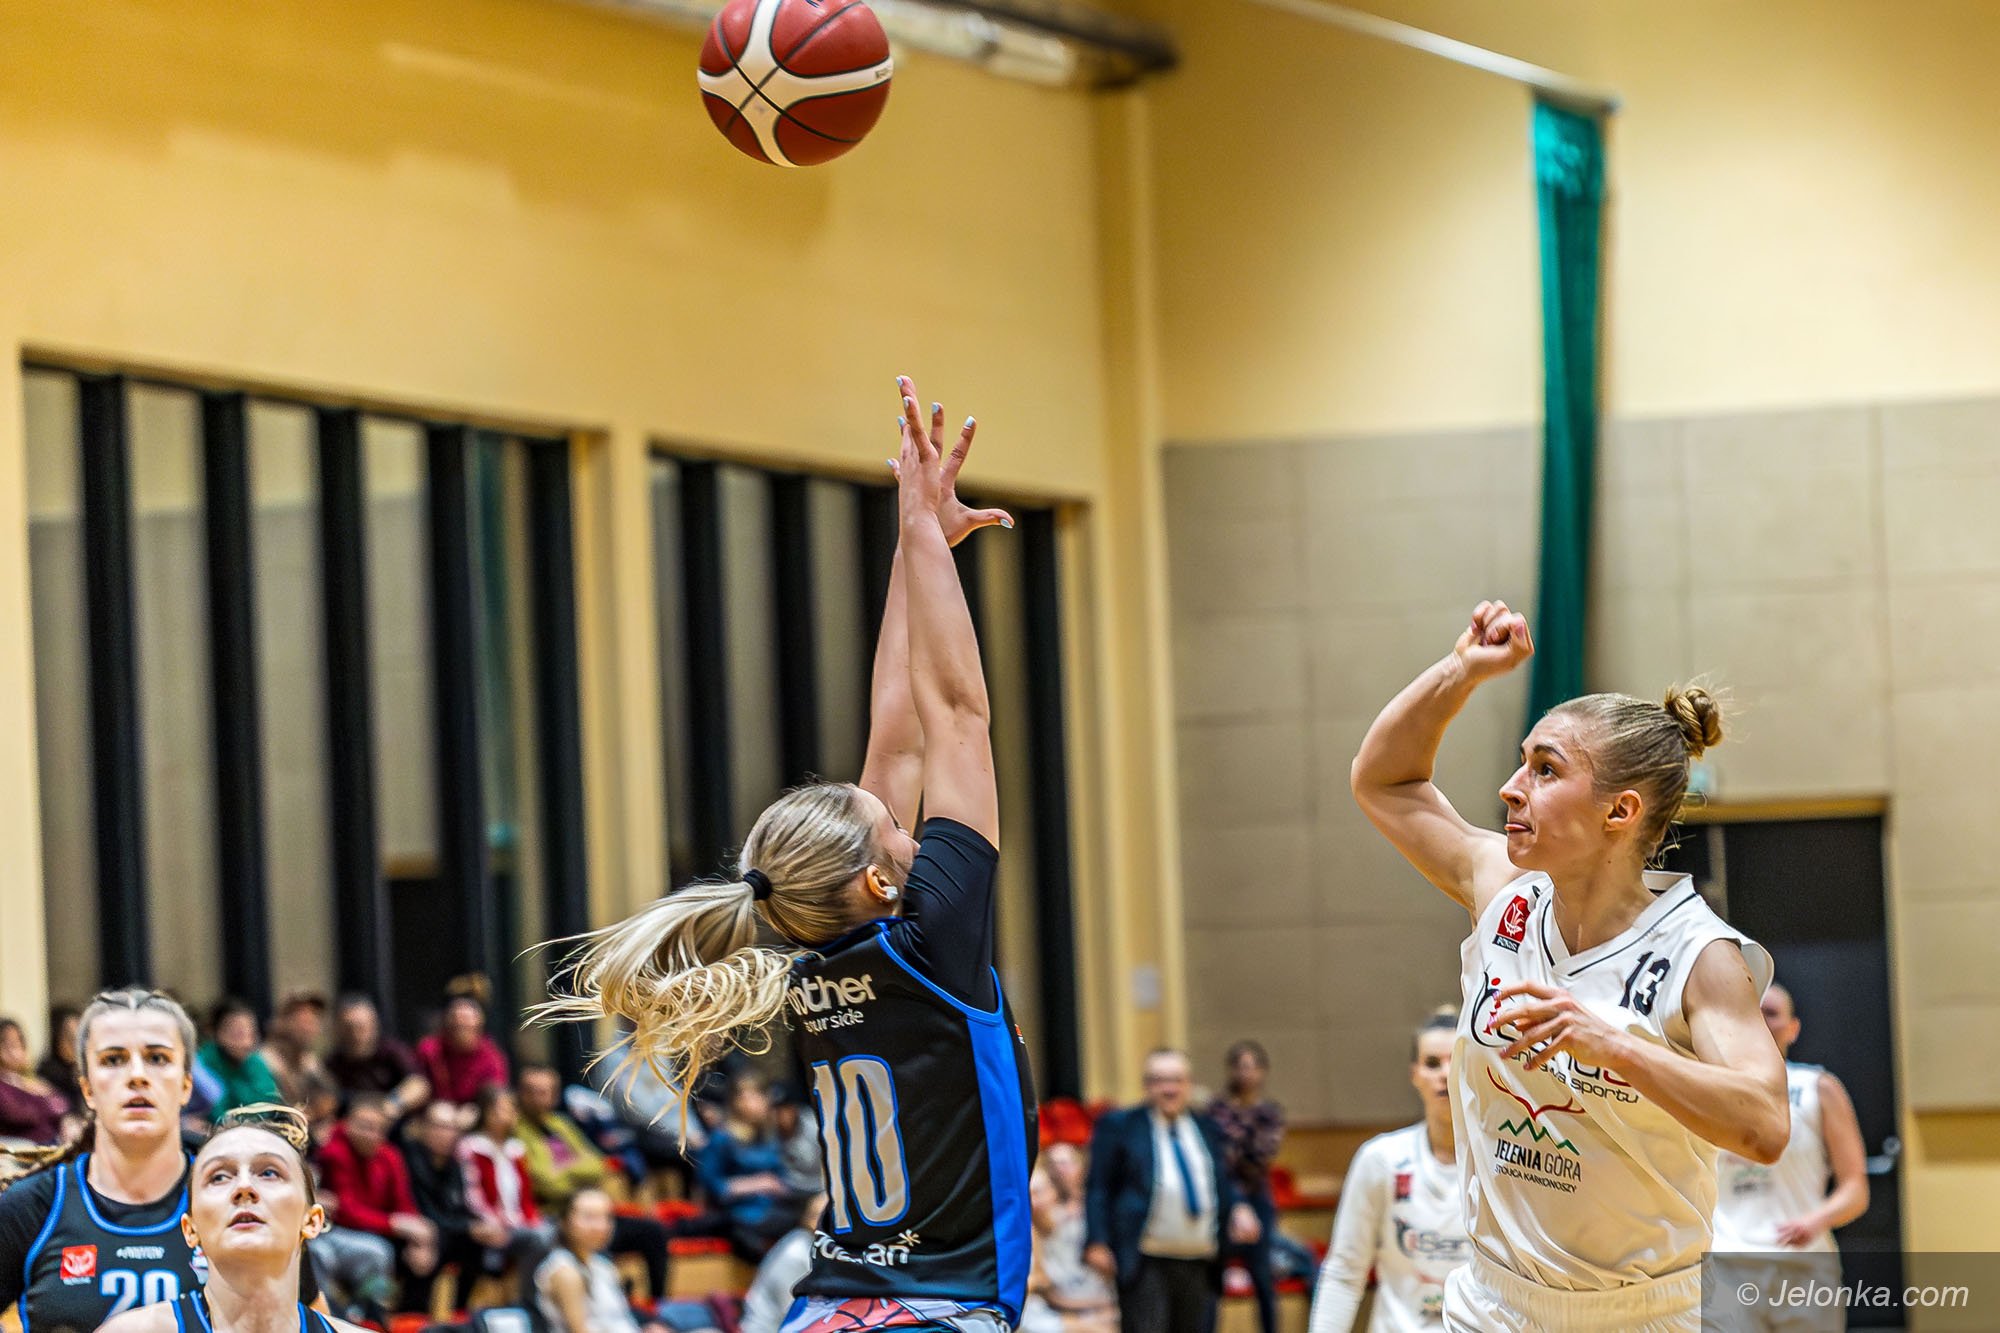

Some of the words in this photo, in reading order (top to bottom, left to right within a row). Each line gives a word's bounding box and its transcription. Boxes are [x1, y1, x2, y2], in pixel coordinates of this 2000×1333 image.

[1618, 951, 1671, 1017] 13
[829, 1008, 864, 1028] side
[1571, 1078, 1639, 1104] sportu
[811, 1054, 911, 1234] 10
[1495, 1138, 1541, 1172] JELENIA
[100, 1267, 180, 1325] 20
